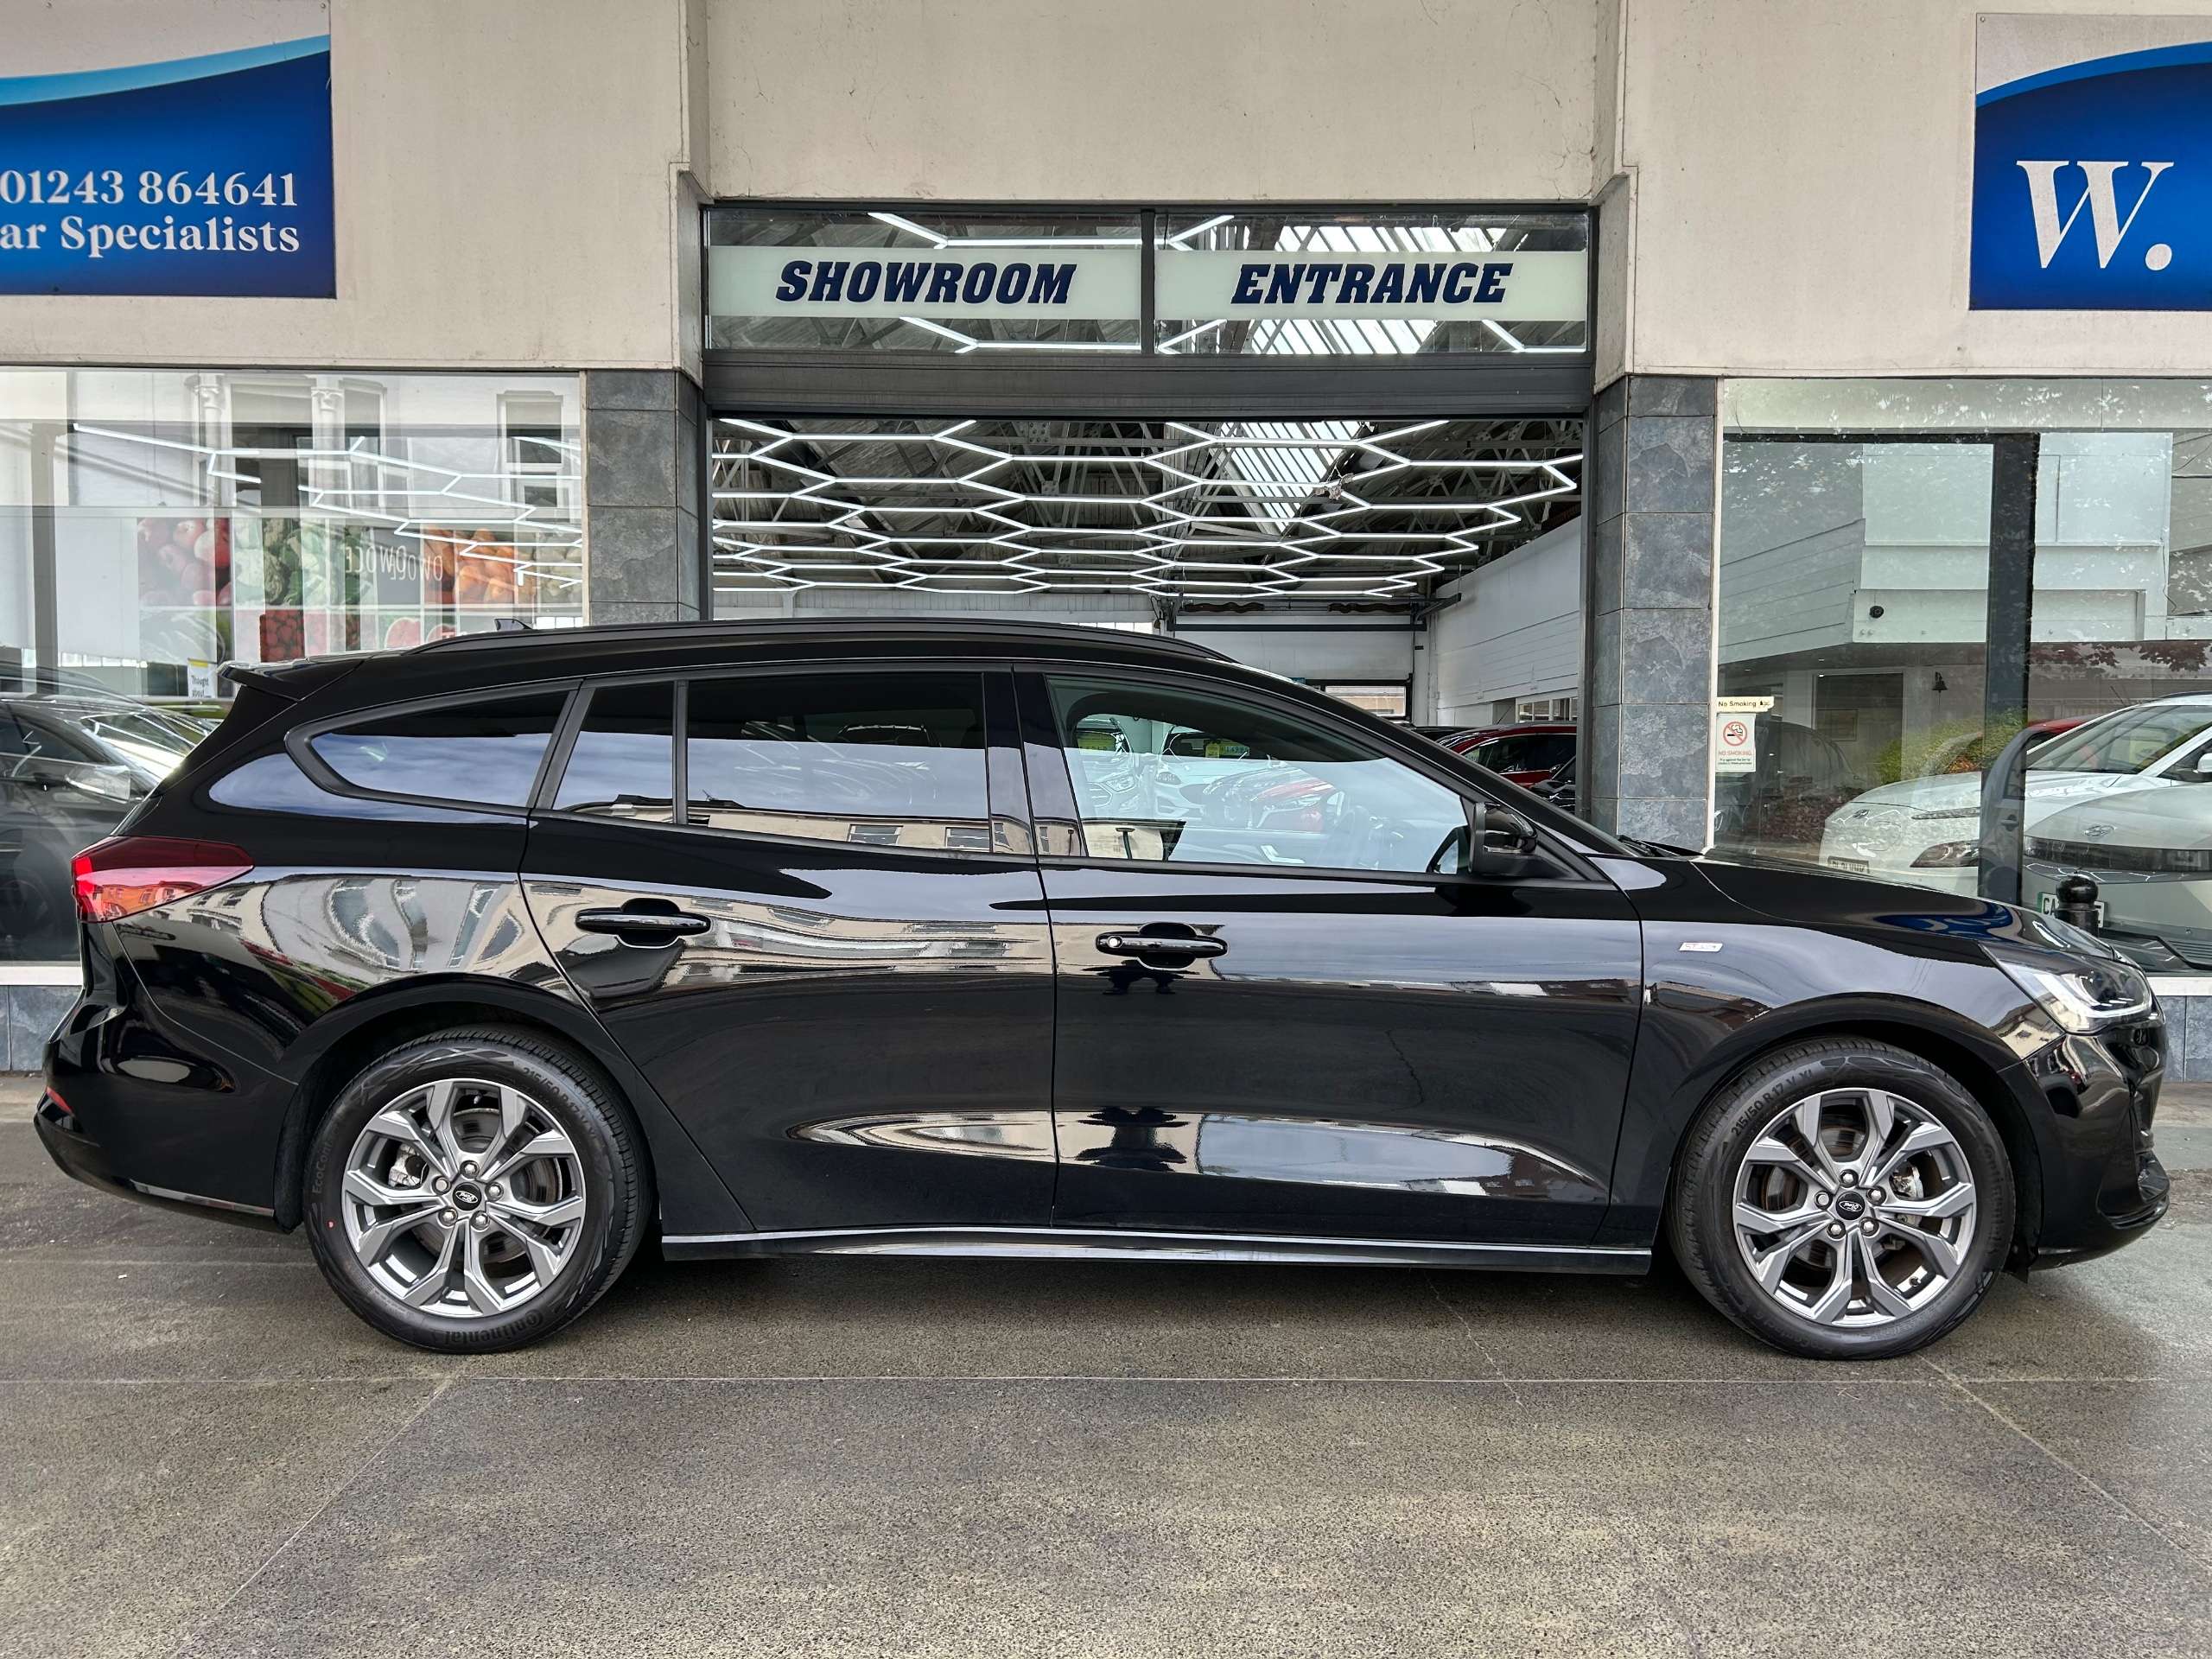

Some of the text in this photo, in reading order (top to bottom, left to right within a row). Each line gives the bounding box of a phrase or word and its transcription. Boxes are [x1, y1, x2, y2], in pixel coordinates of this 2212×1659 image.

[0, 170, 298, 206] 01243 864641
[0, 215, 300, 257] ar Specialists
[2016, 160, 2174, 271] W.
[775, 260, 1077, 304] SHOWROOM
[1230, 262, 1514, 304] ENTRANCE
[1731, 1100, 1764, 1136] 215/50
[1763, 1092, 1773, 1103] R
[1771, 1083, 1783, 1096] 17
